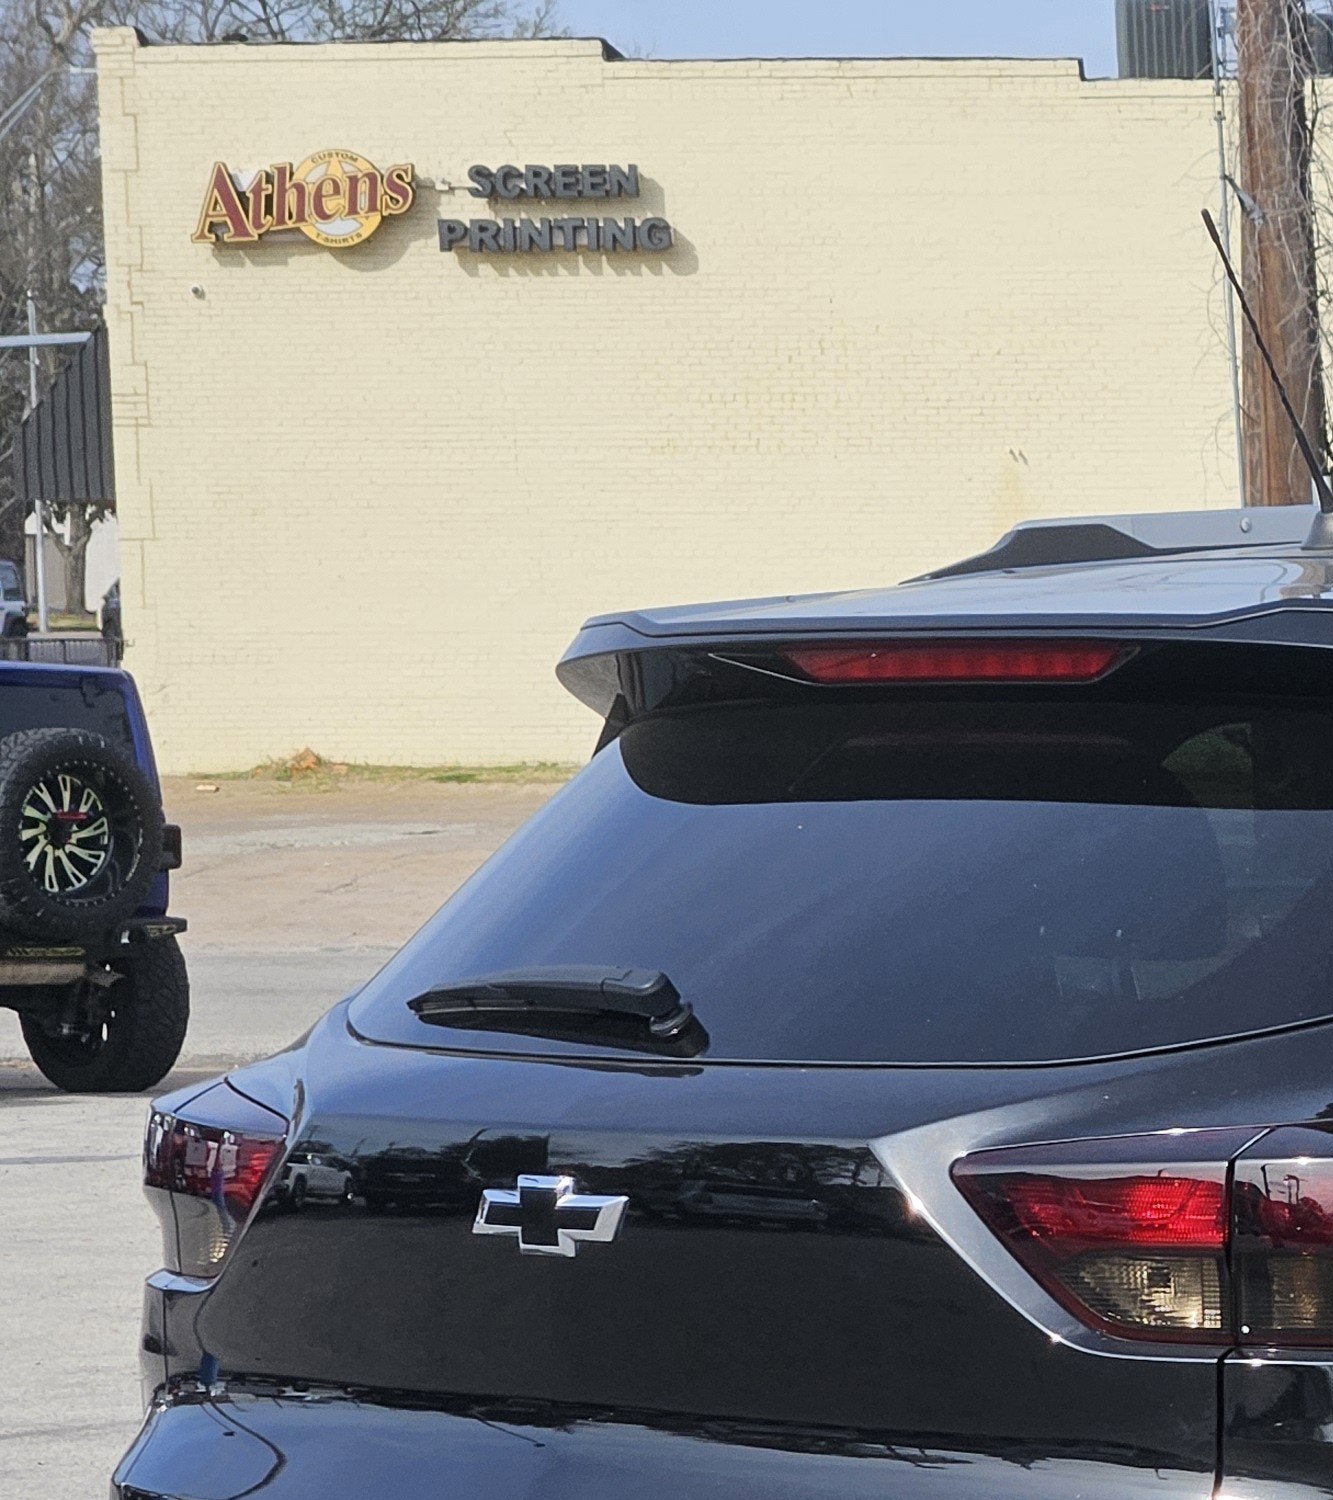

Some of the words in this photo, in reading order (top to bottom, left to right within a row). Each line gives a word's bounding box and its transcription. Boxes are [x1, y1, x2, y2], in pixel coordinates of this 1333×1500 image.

[311, 151, 358, 164] CUSTOM
[467, 163, 641, 200] SCREEN
[191, 160, 416, 244] Athens
[315, 231, 363, 245] T-SHIRTS
[437, 216, 674, 253] PRINTING
